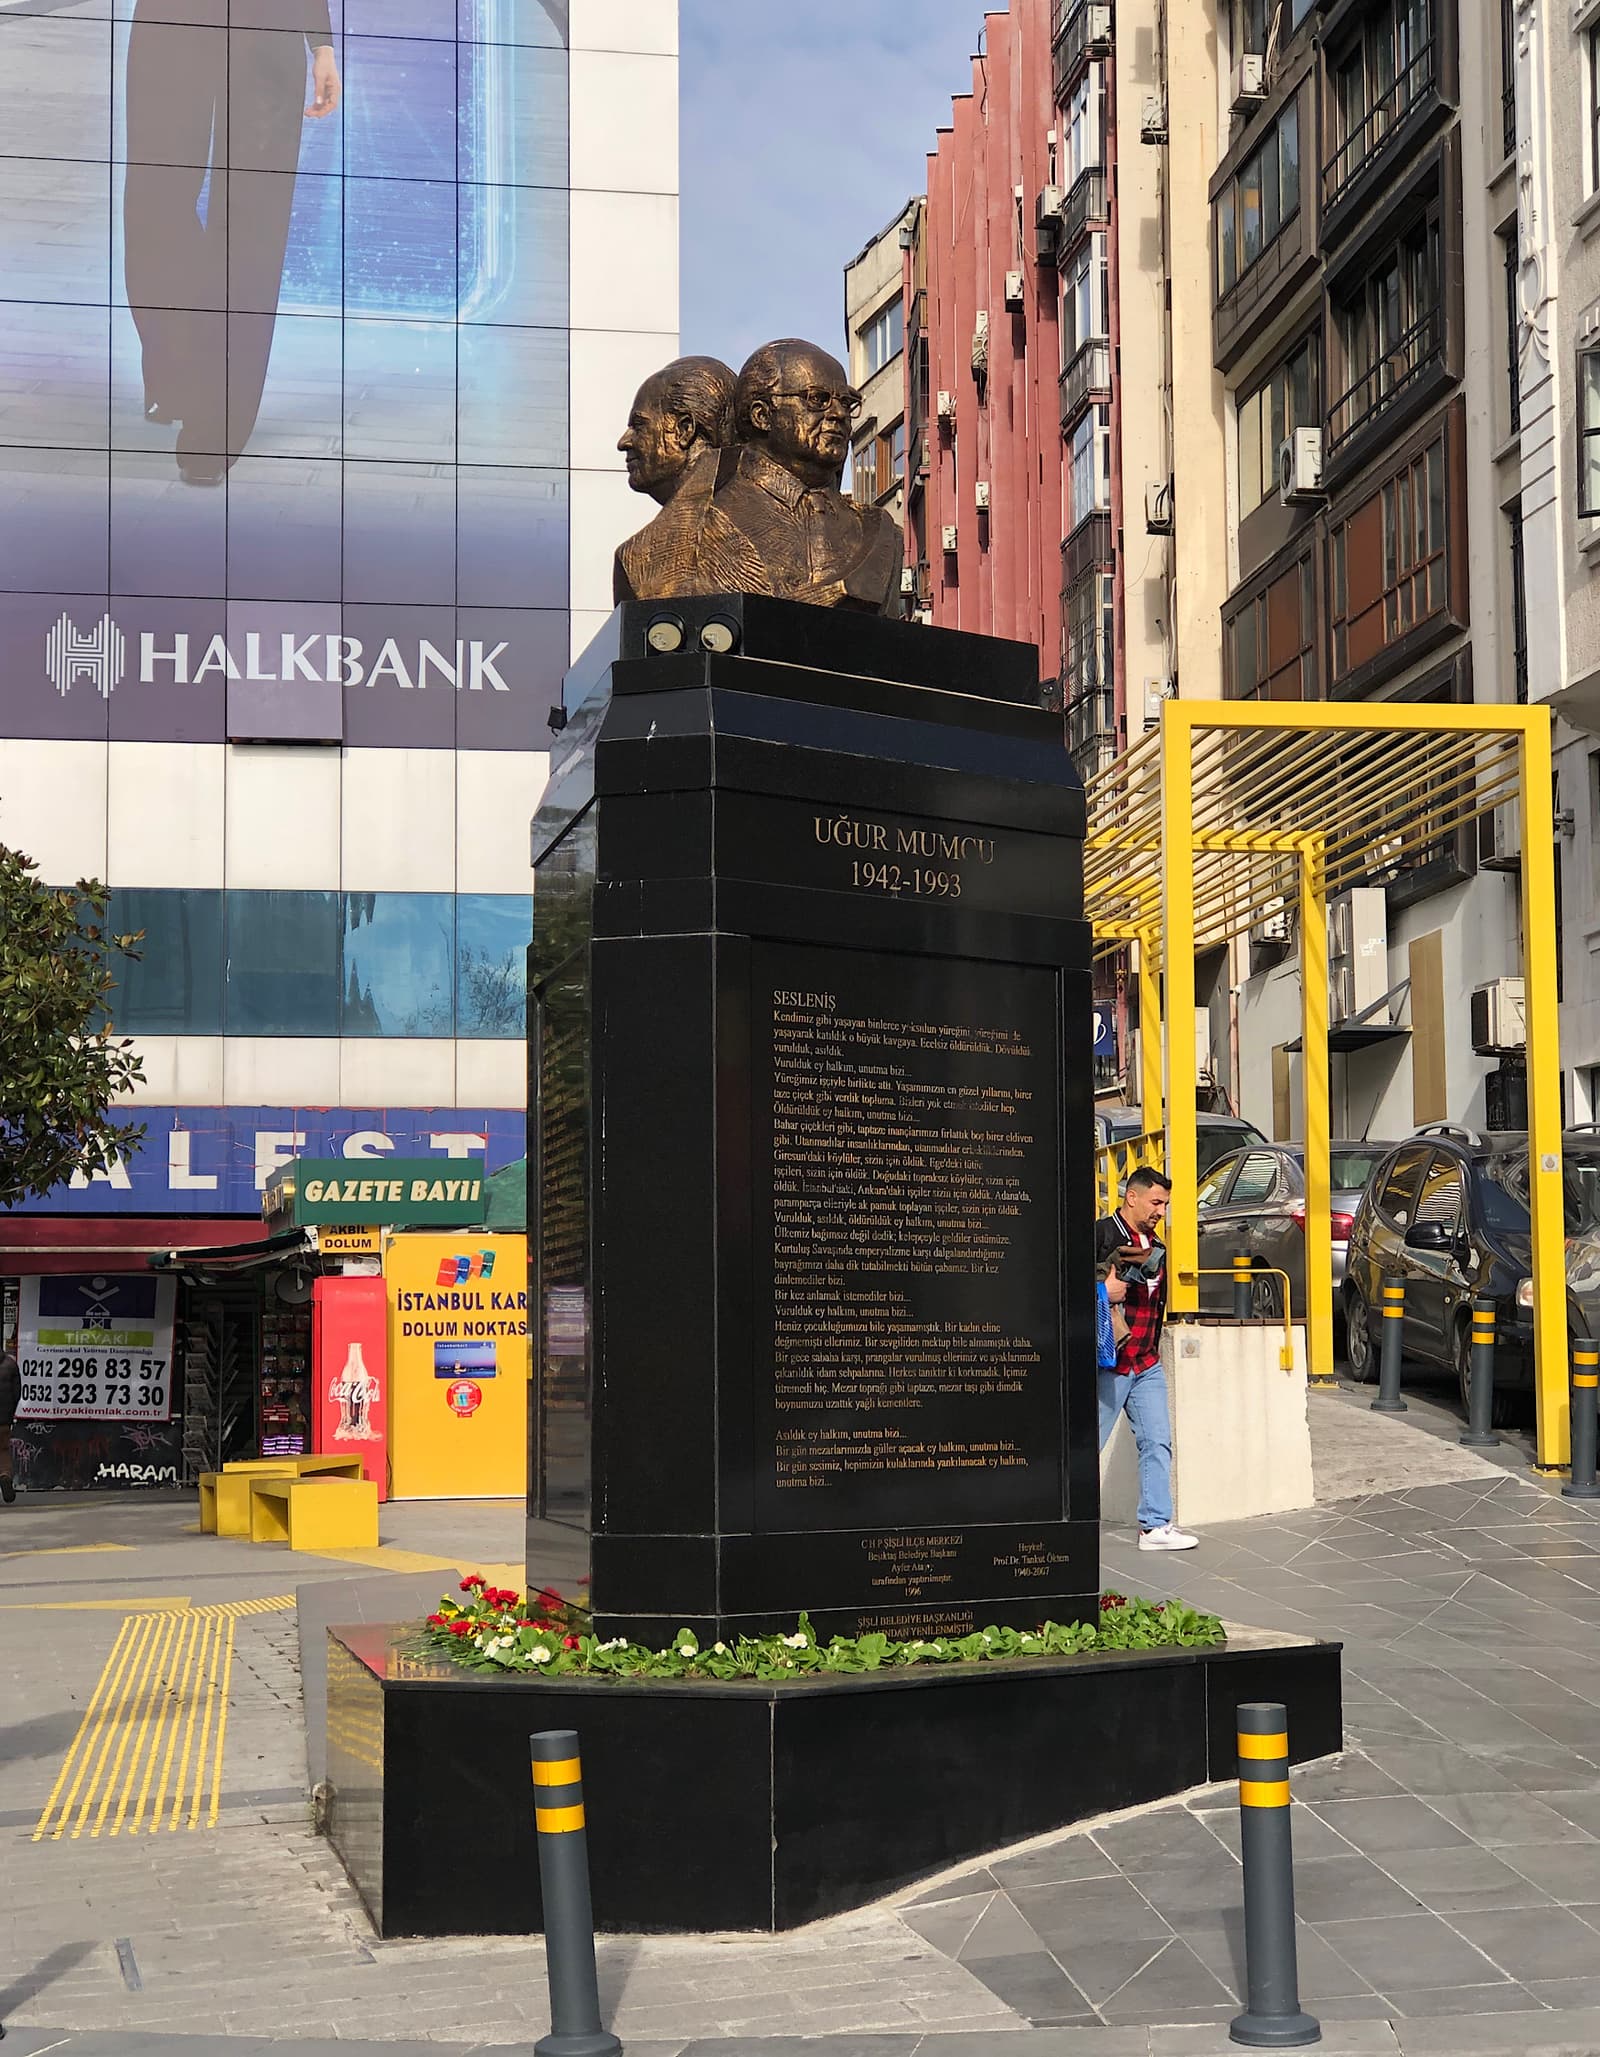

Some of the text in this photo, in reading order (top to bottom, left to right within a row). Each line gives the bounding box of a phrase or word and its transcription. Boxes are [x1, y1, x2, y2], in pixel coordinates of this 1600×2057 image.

[139, 632, 511, 691] HALKBANK
[813, 814, 996, 865] UĞUR MUMCU
[851, 860, 962, 898] 1942-1993
[773, 990, 836, 1011] SESLENİŞ
[305, 1180, 404, 1202] GAZETE
[324, 1239, 371, 1249] DOLUM
[397, 1288, 485, 1311] İSTANBUL
[64, 1331, 129, 1345] TİRYAKİ
[403, 1321, 527, 1336] DOLUM NOKTAS
[22, 1358, 166, 1380] 0212 296 83 57
[22, 1384, 164, 1406] 0532 323 73 30
[22, 1406, 162, 1417] www.tiryakiemlak.com.tr
[97, 1463, 177, 1481] HARAM
[926, 1536, 963, 1546] MERKEZİ
